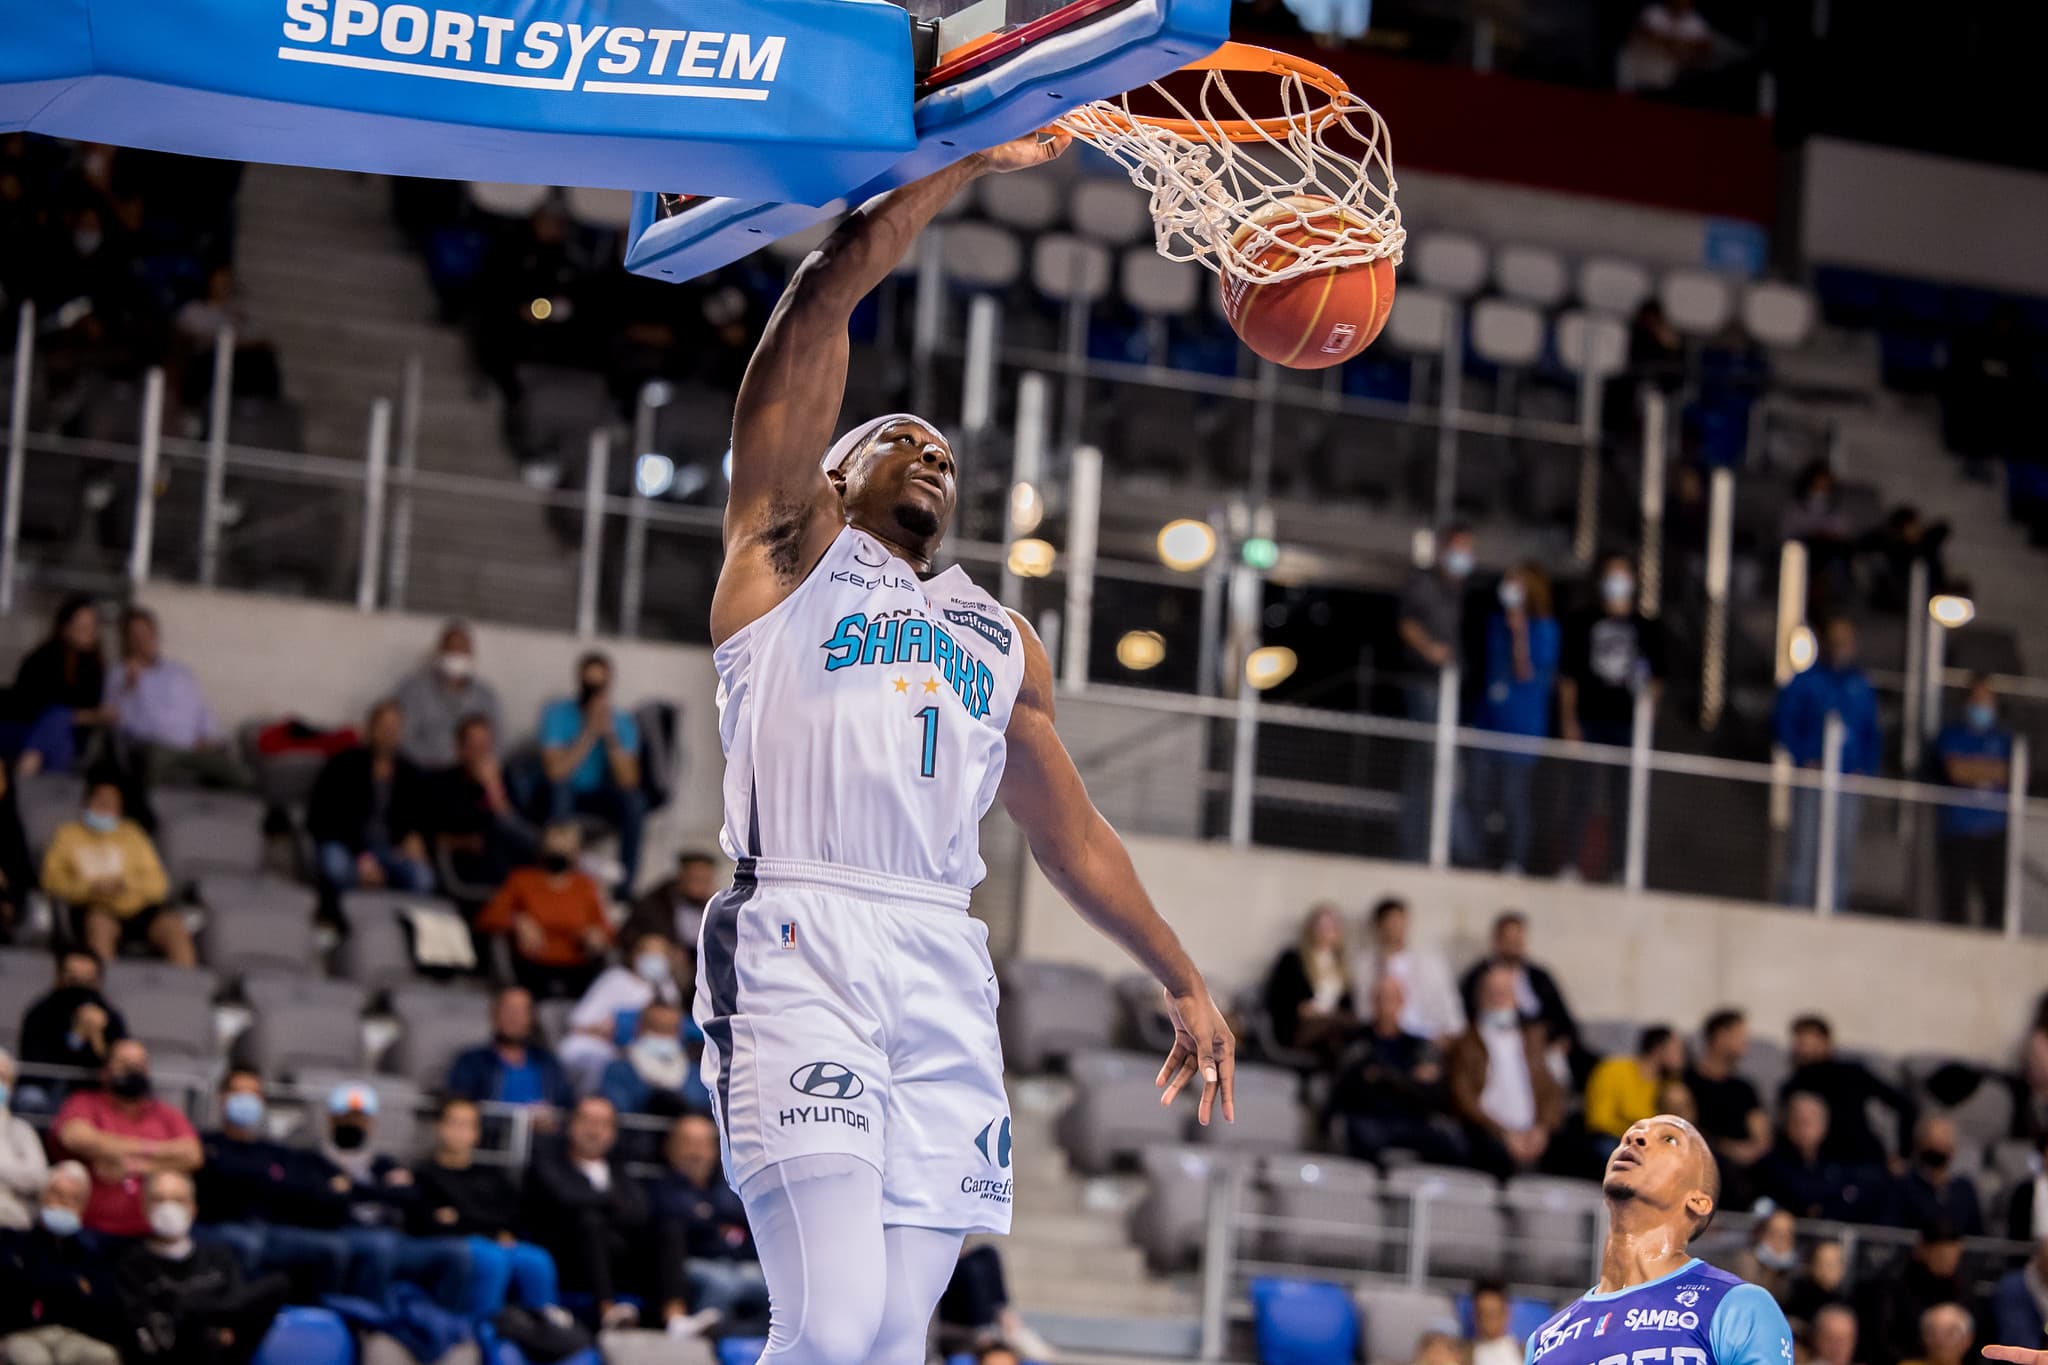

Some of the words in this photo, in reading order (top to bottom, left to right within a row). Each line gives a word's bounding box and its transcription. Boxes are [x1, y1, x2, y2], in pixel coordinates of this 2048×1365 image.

[283, 0, 514, 65] SPORT
[515, 21, 786, 90] SYSTEM
[949, 612, 1009, 647] bpifrance
[819, 612, 995, 721] SHARKS
[914, 706, 940, 779] 1
[779, 1106, 870, 1134] HYUNDAI
[1624, 1308, 1699, 1331] SAMBO
